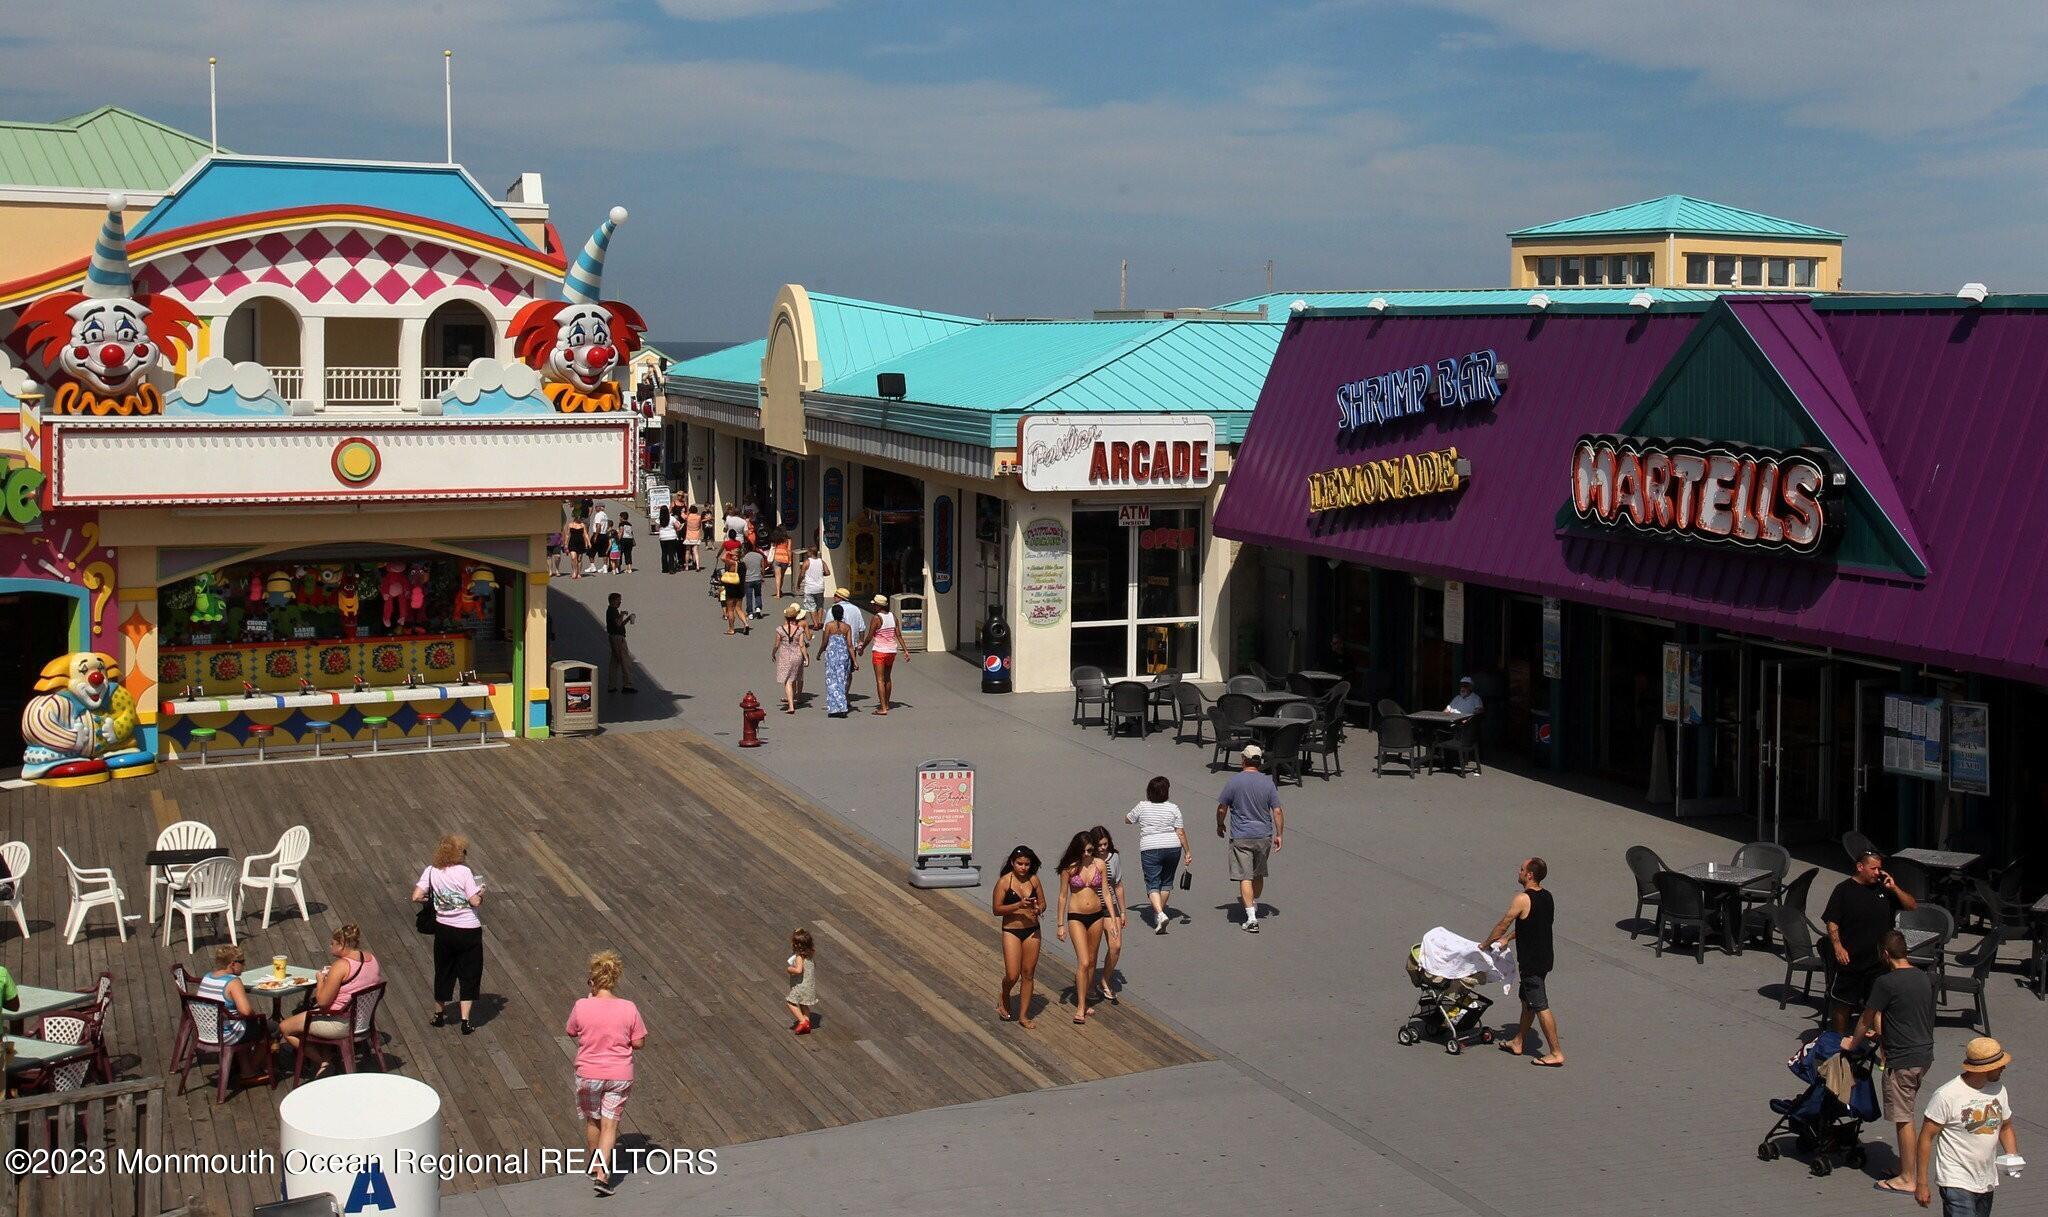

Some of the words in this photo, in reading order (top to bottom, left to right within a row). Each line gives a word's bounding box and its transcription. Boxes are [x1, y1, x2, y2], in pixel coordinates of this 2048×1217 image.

[1336, 364, 1432, 432] SHRIMP
[1437, 349, 1501, 407] BAR
[1089, 440, 1209, 485] ARCADE
[1308, 446, 1460, 513] LEMONADE
[1120, 505, 1150, 520] ATM
[1573, 445, 1823, 546] MARTELLS
[1140, 528, 1196, 551] OPEN
[344, 1160, 397, 1214] A
